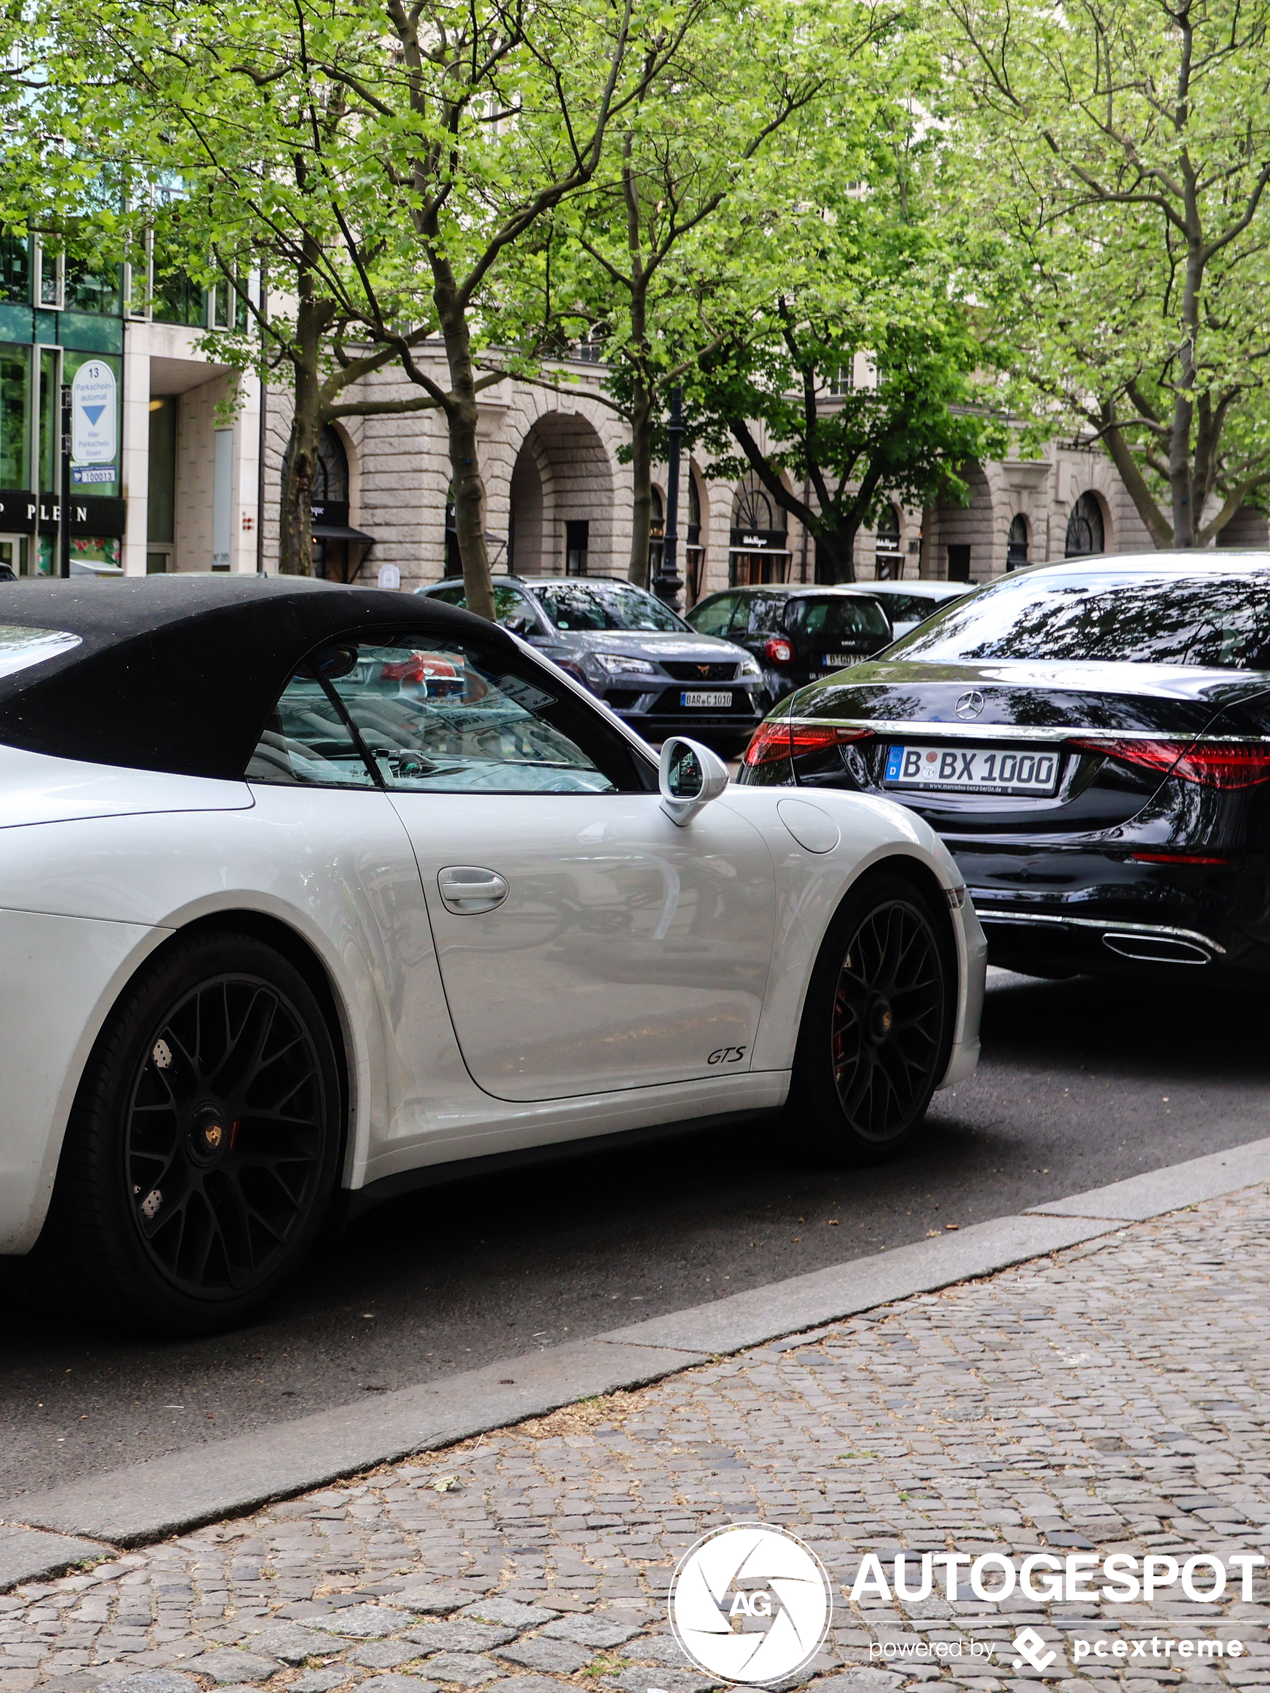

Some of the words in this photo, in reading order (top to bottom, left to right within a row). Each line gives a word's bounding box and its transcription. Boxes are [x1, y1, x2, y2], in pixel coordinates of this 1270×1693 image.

[89, 367, 100, 378] 13
[75, 383, 113, 392] Parkschein-
[81, 393, 108, 402] automat
[88, 431, 100, 439] Hier
[78, 440, 110, 448] Parkschein
[86, 472, 112, 481] 100013
[27, 503, 88, 522] PLEN
[686, 695, 702, 705] BAR
[706, 695, 712, 705] C
[714, 695, 732, 705] 1010
[889, 767, 897, 776] D
[903, 751, 922, 778] B
[938, 752, 977, 781] BX
[980, 754, 1054, 784] 1000
[930, 783, 1002, 793] www.mercedes-benz-berlin.de
[707, 1045, 747, 1065] GTS
